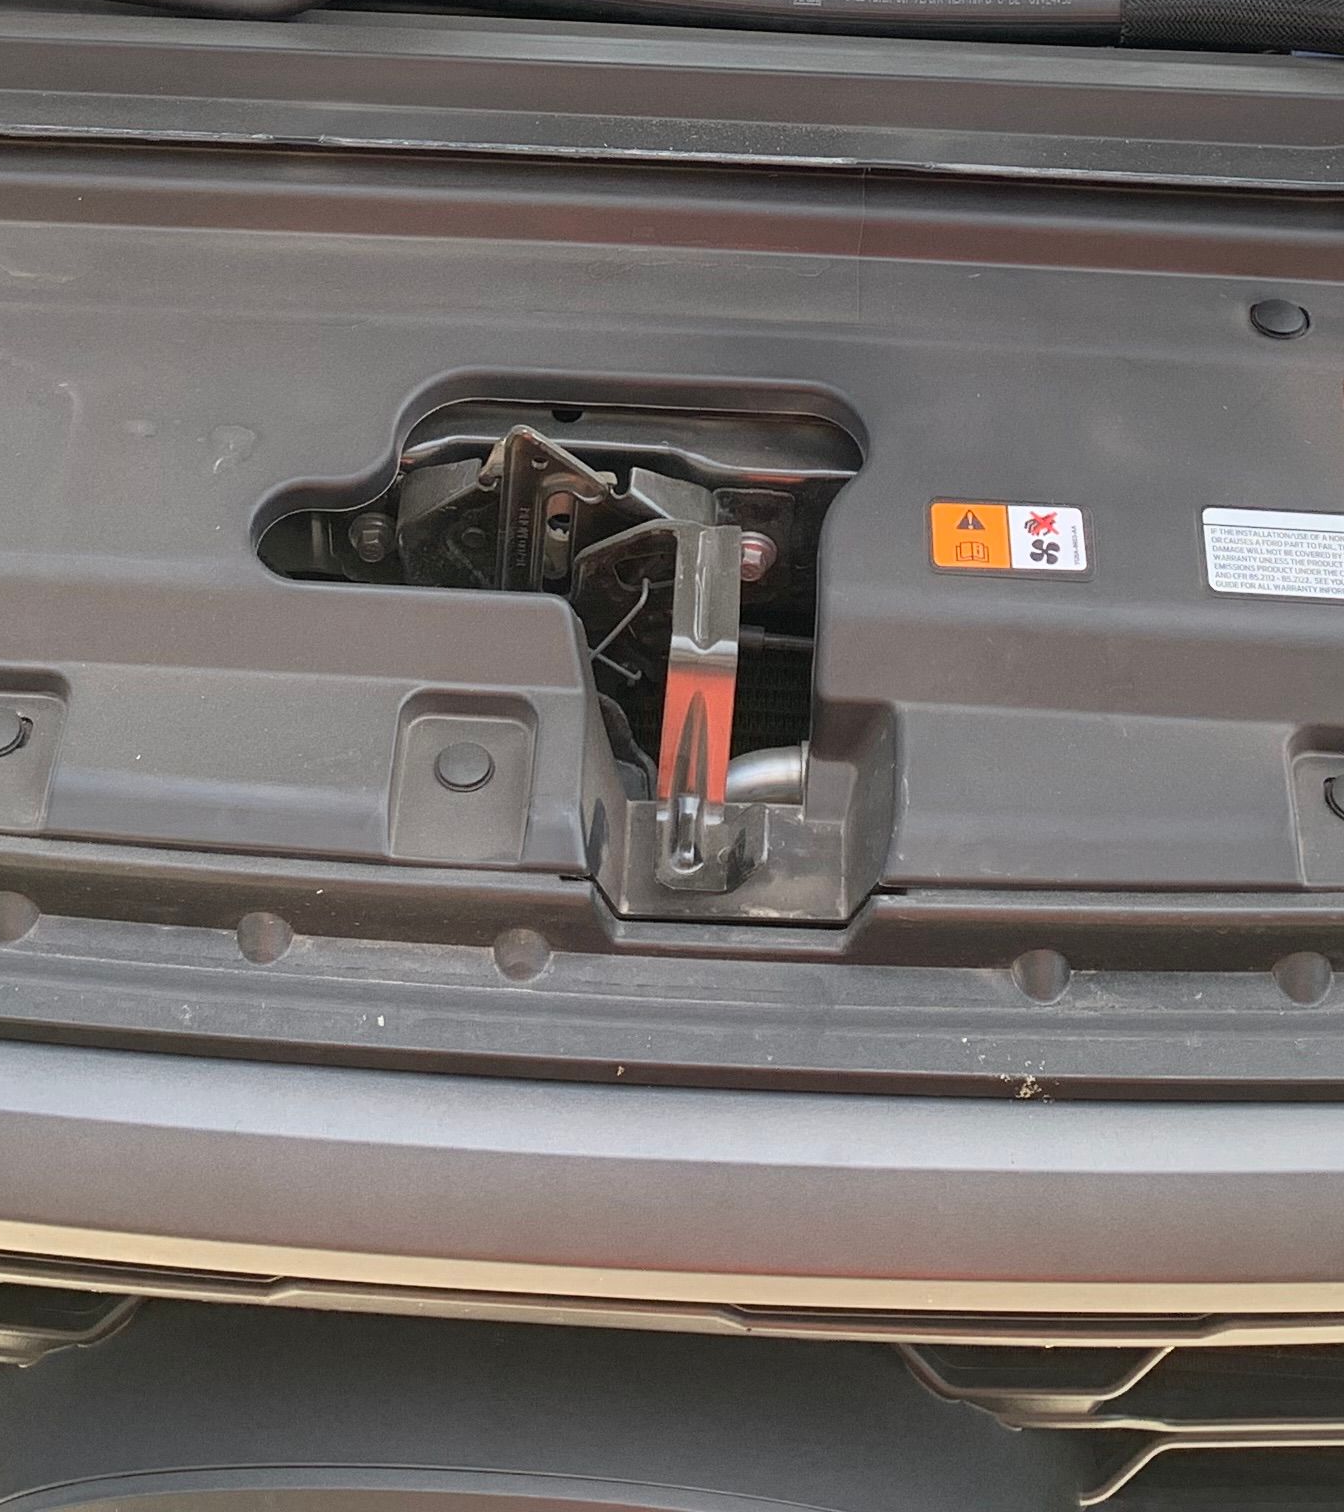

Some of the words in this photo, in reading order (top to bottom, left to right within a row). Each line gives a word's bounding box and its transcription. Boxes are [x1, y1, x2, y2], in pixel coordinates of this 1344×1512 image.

[1235, 529, 1307, 540] INSTALLATION/USE
[1223, 537, 1253, 545] CAUSES
[1262, 539, 1282, 547] FORD
[1283, 540, 1303, 548] PART
[1212, 545, 1245, 553] DAMAGE
[1294, 550, 1330, 558] COVERED
[1212, 554, 1257, 563] WARRANTY
[1258, 556, 1289, 564] UNLESS
[1306, 559, 1343, 567] PRODUCT
[1214, 563, 1255, 571] EMISSIONS
[1256, 565, 1292, 573] PRODUCT
[1294, 567, 1322, 575] UNDER
[1215, 580, 1239, 588] GUIDE
[1240, 581, 1256, 589] FOR
[1272, 583, 1317, 592] WARRANTY
